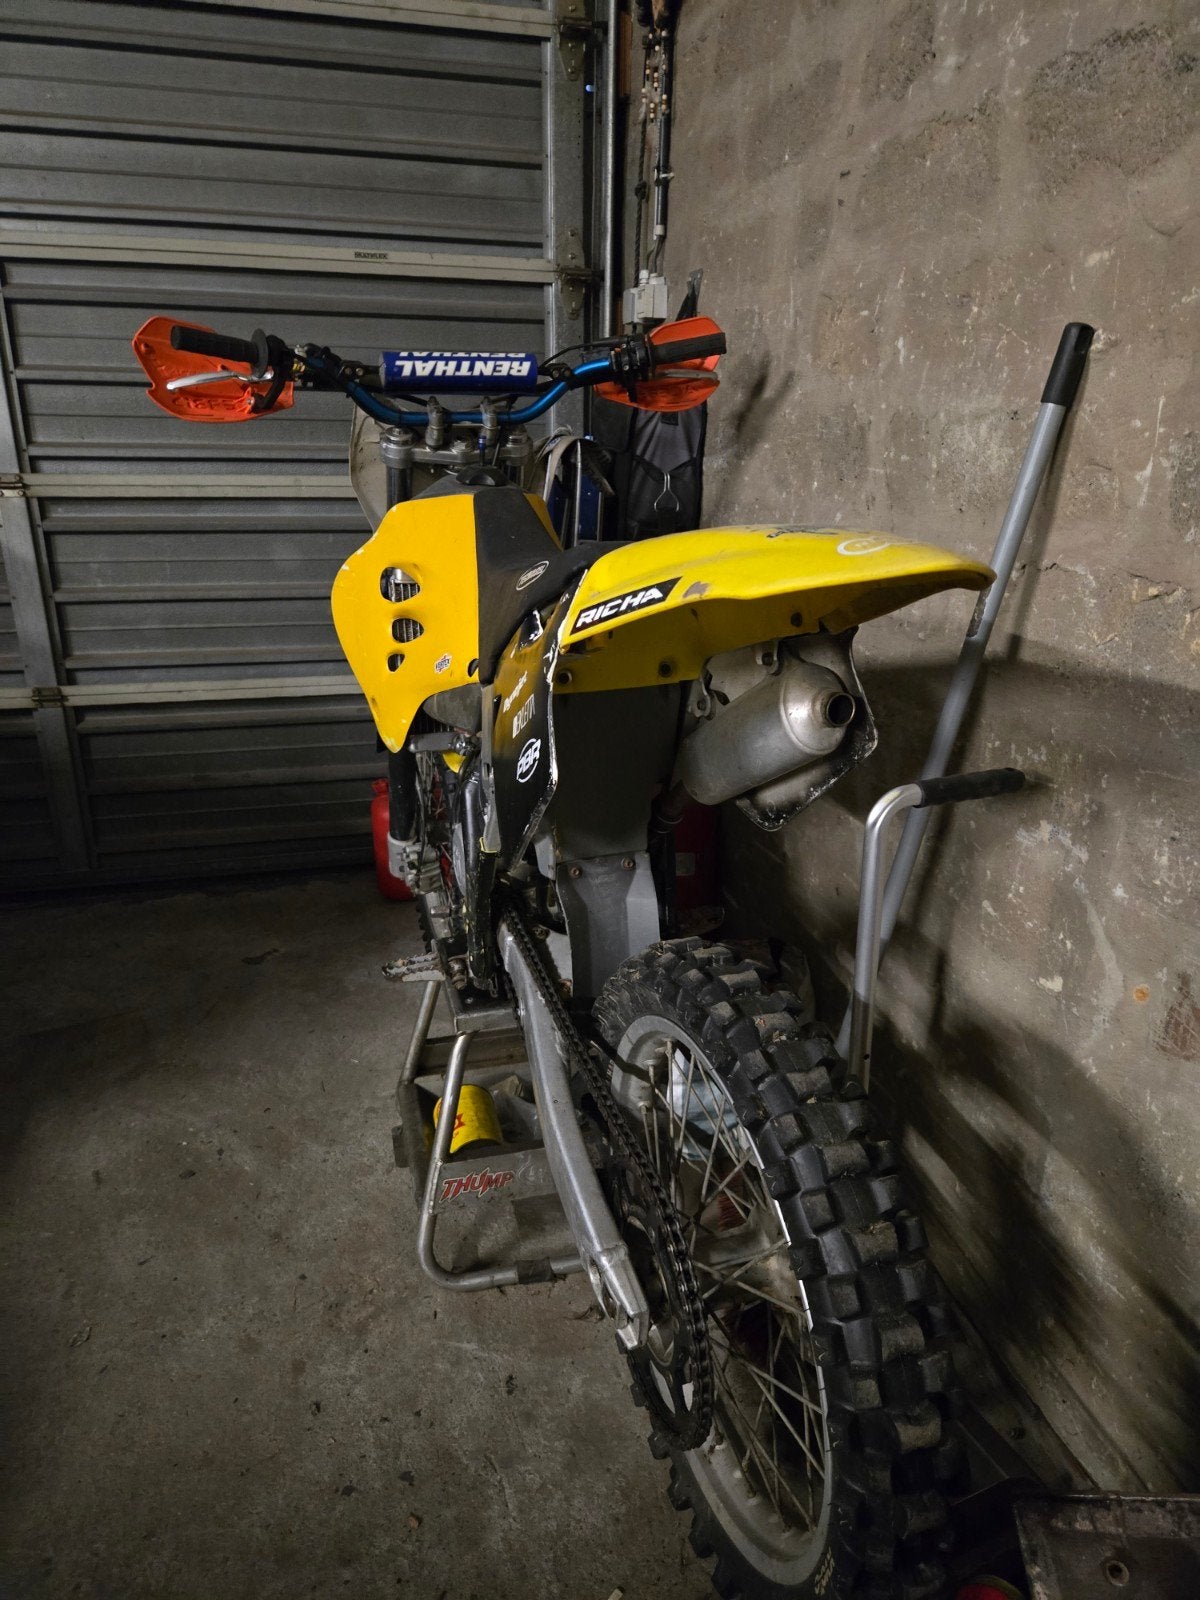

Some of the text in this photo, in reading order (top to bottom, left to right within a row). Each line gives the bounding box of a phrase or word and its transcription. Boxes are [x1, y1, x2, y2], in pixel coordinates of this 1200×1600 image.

[395, 360, 532, 377] RENTHAL
[575, 587, 664, 629] RICHA
[439, 1167, 516, 1203] THUMP
